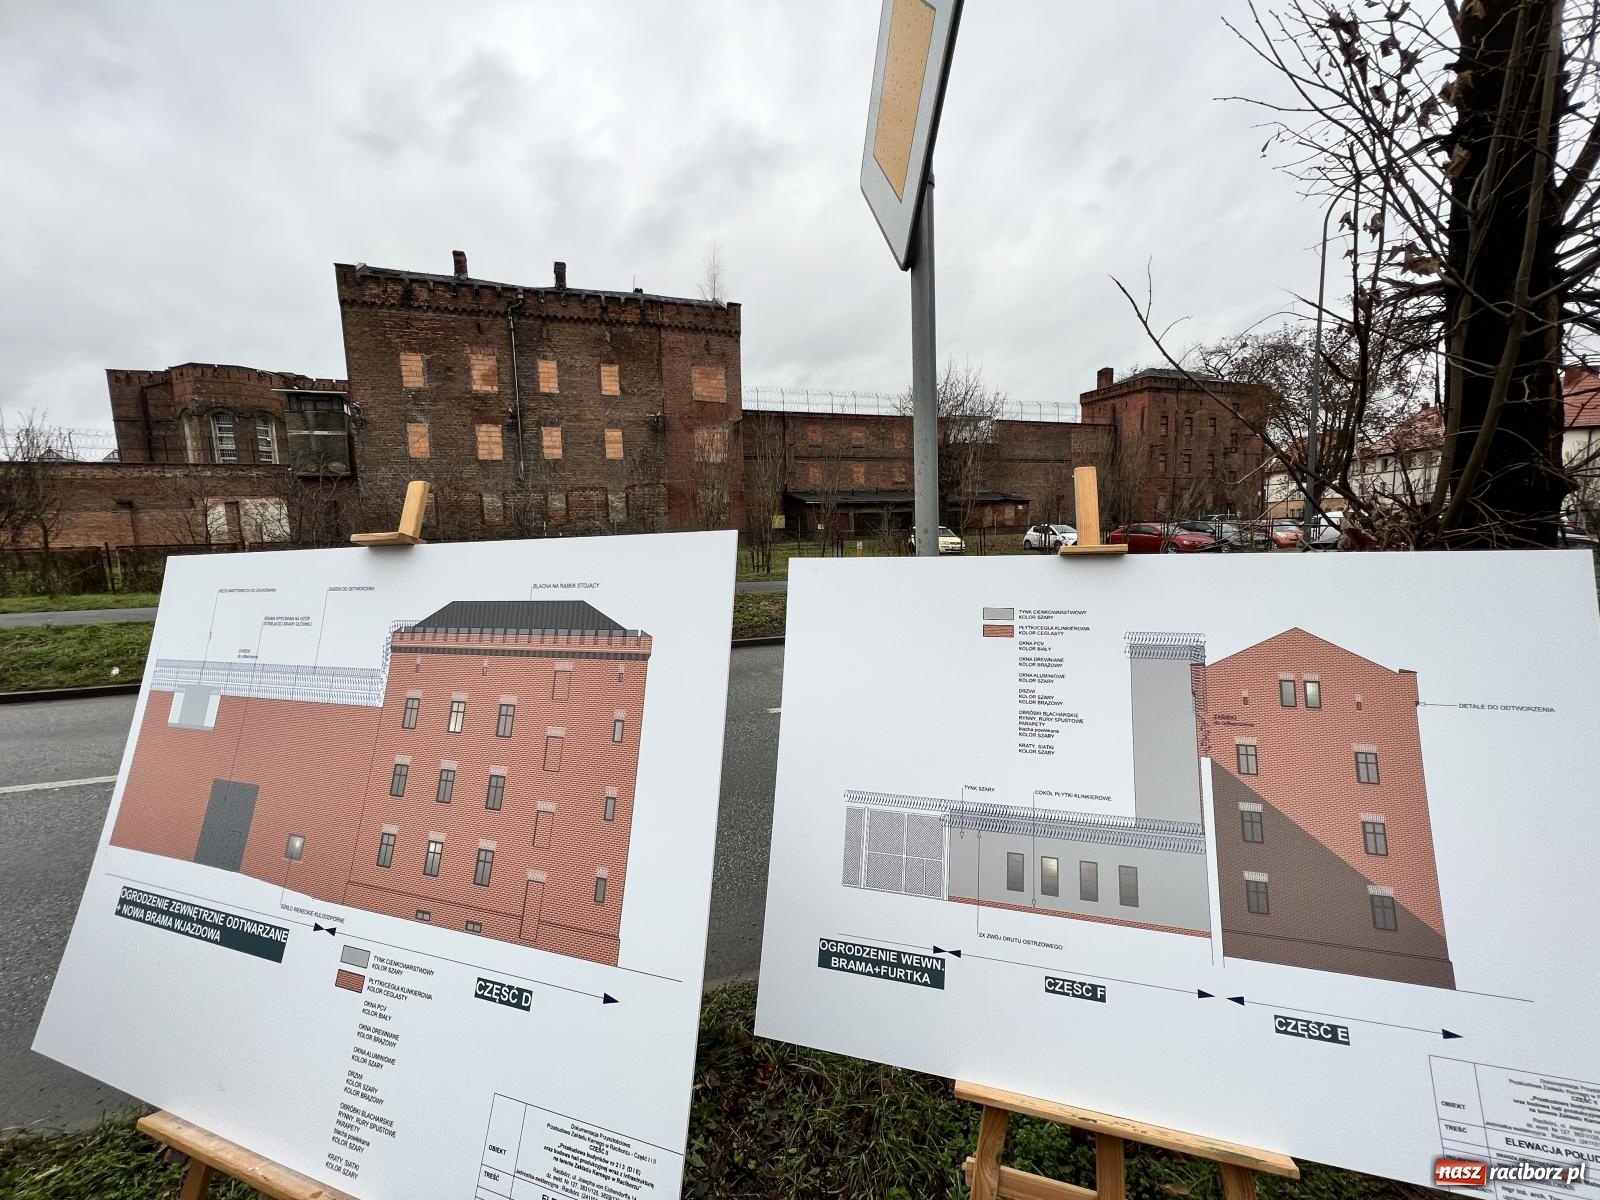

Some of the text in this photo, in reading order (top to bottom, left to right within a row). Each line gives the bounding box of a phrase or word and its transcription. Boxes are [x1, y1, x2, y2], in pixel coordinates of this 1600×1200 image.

[120, 888, 288, 943] OGRODZENIE ZEWNĘTRZNE ODTWARZANE
[122, 904, 144, 919] NOWA
[145, 911, 172, 928] BRAMA
[174, 918, 220, 942] WJAZDOWA
[819, 940, 944, 971] OGRODZENIE WEWN.
[372, 963, 403, 976] KOLOR SZARY
[831, 957, 931, 984] BRAMA+FURTKA
[367, 986, 408, 1001] KOLOR CEGLASTY
[476, 981, 531, 1006] CZĘŚĆ D
[1045, 979, 1105, 998] CZĘŚĆ F
[362, 1008, 378, 1017] KOLOR
[364, 1000, 387, 1012] OKNA PCV
[359, 1023, 371, 1032] OKNA
[1275, 1018, 1348, 1041] CZĘŚĆ E
[357, 1031, 372, 1041] KOLOR
[352, 1055, 383, 1069] KOLOR SZARY
[344, 1087, 360, 1096] KOLOR
[346, 1079, 378, 1094] KOLOR SZARY
[336, 1119, 360, 1133] PARAPETY
[356, 1117, 369, 1127] RURY
[332, 1136, 364, 1154] KOLOR SZARY
[489, 1145, 506, 1155] OBIEKT
[1505, 1137, 1563, 1156] ELEWACJA
[326, 1161, 358, 1180] KOLOR SZARY
